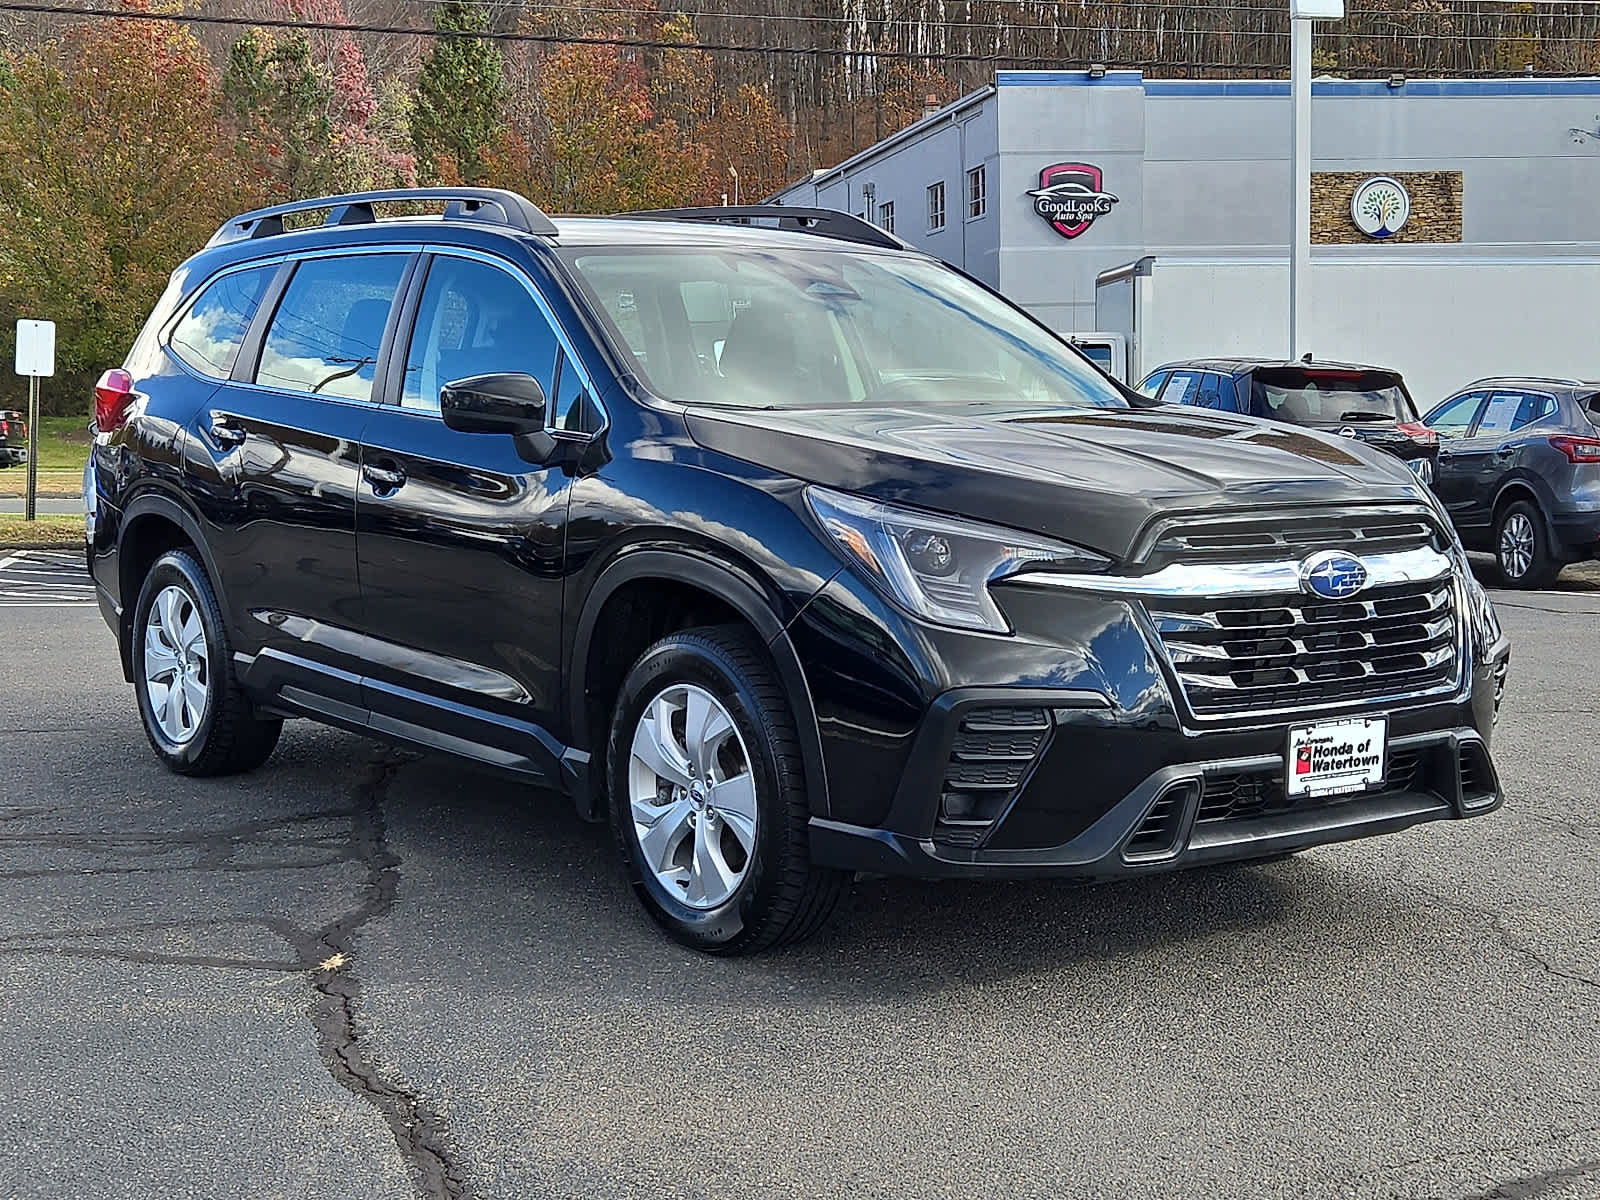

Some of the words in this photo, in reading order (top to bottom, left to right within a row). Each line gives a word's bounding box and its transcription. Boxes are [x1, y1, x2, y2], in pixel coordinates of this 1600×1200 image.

[1053, 211, 1074, 220] Auto
[1076, 211, 1093, 222] Spa
[1313, 742, 1353, 758] Honda
[1357, 739, 1371, 752] of
[1312, 754, 1379, 772] Watertown
